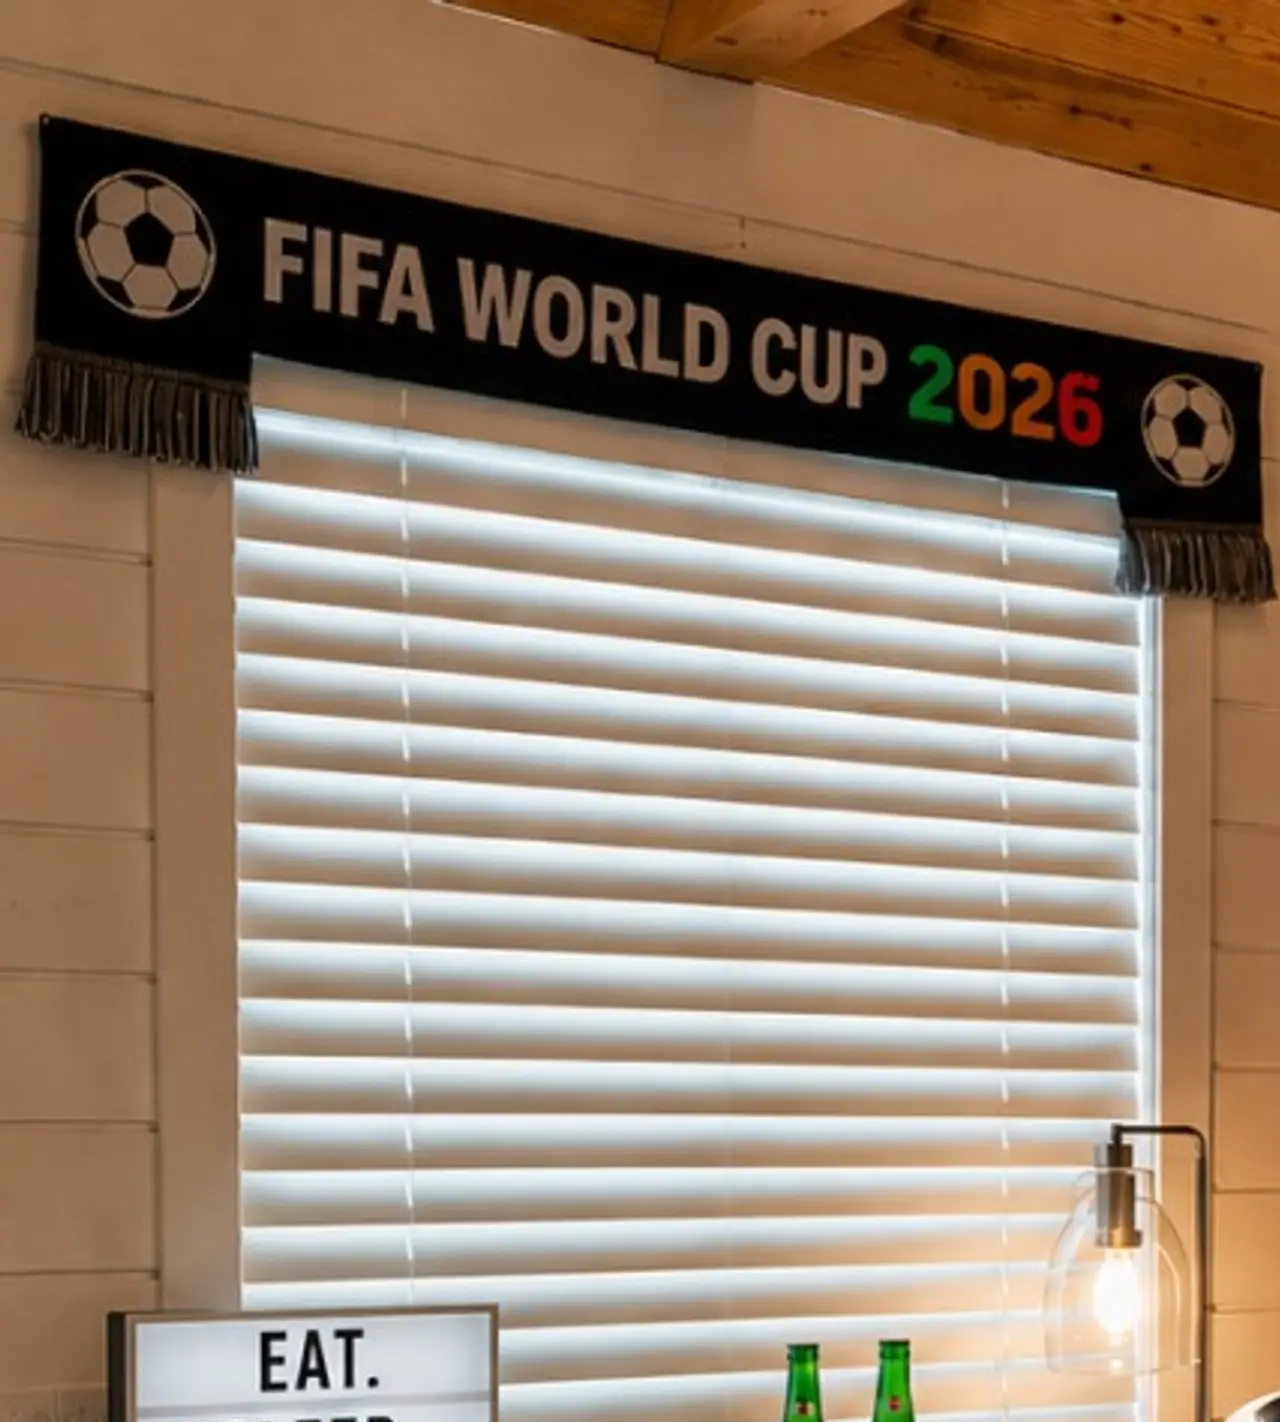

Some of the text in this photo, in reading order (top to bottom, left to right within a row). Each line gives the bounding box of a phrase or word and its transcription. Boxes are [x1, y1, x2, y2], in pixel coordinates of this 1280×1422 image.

[264, 218, 1104, 448] FIFA WORLD CUP 2026
[261, 1328, 380, 1394] EAT.
